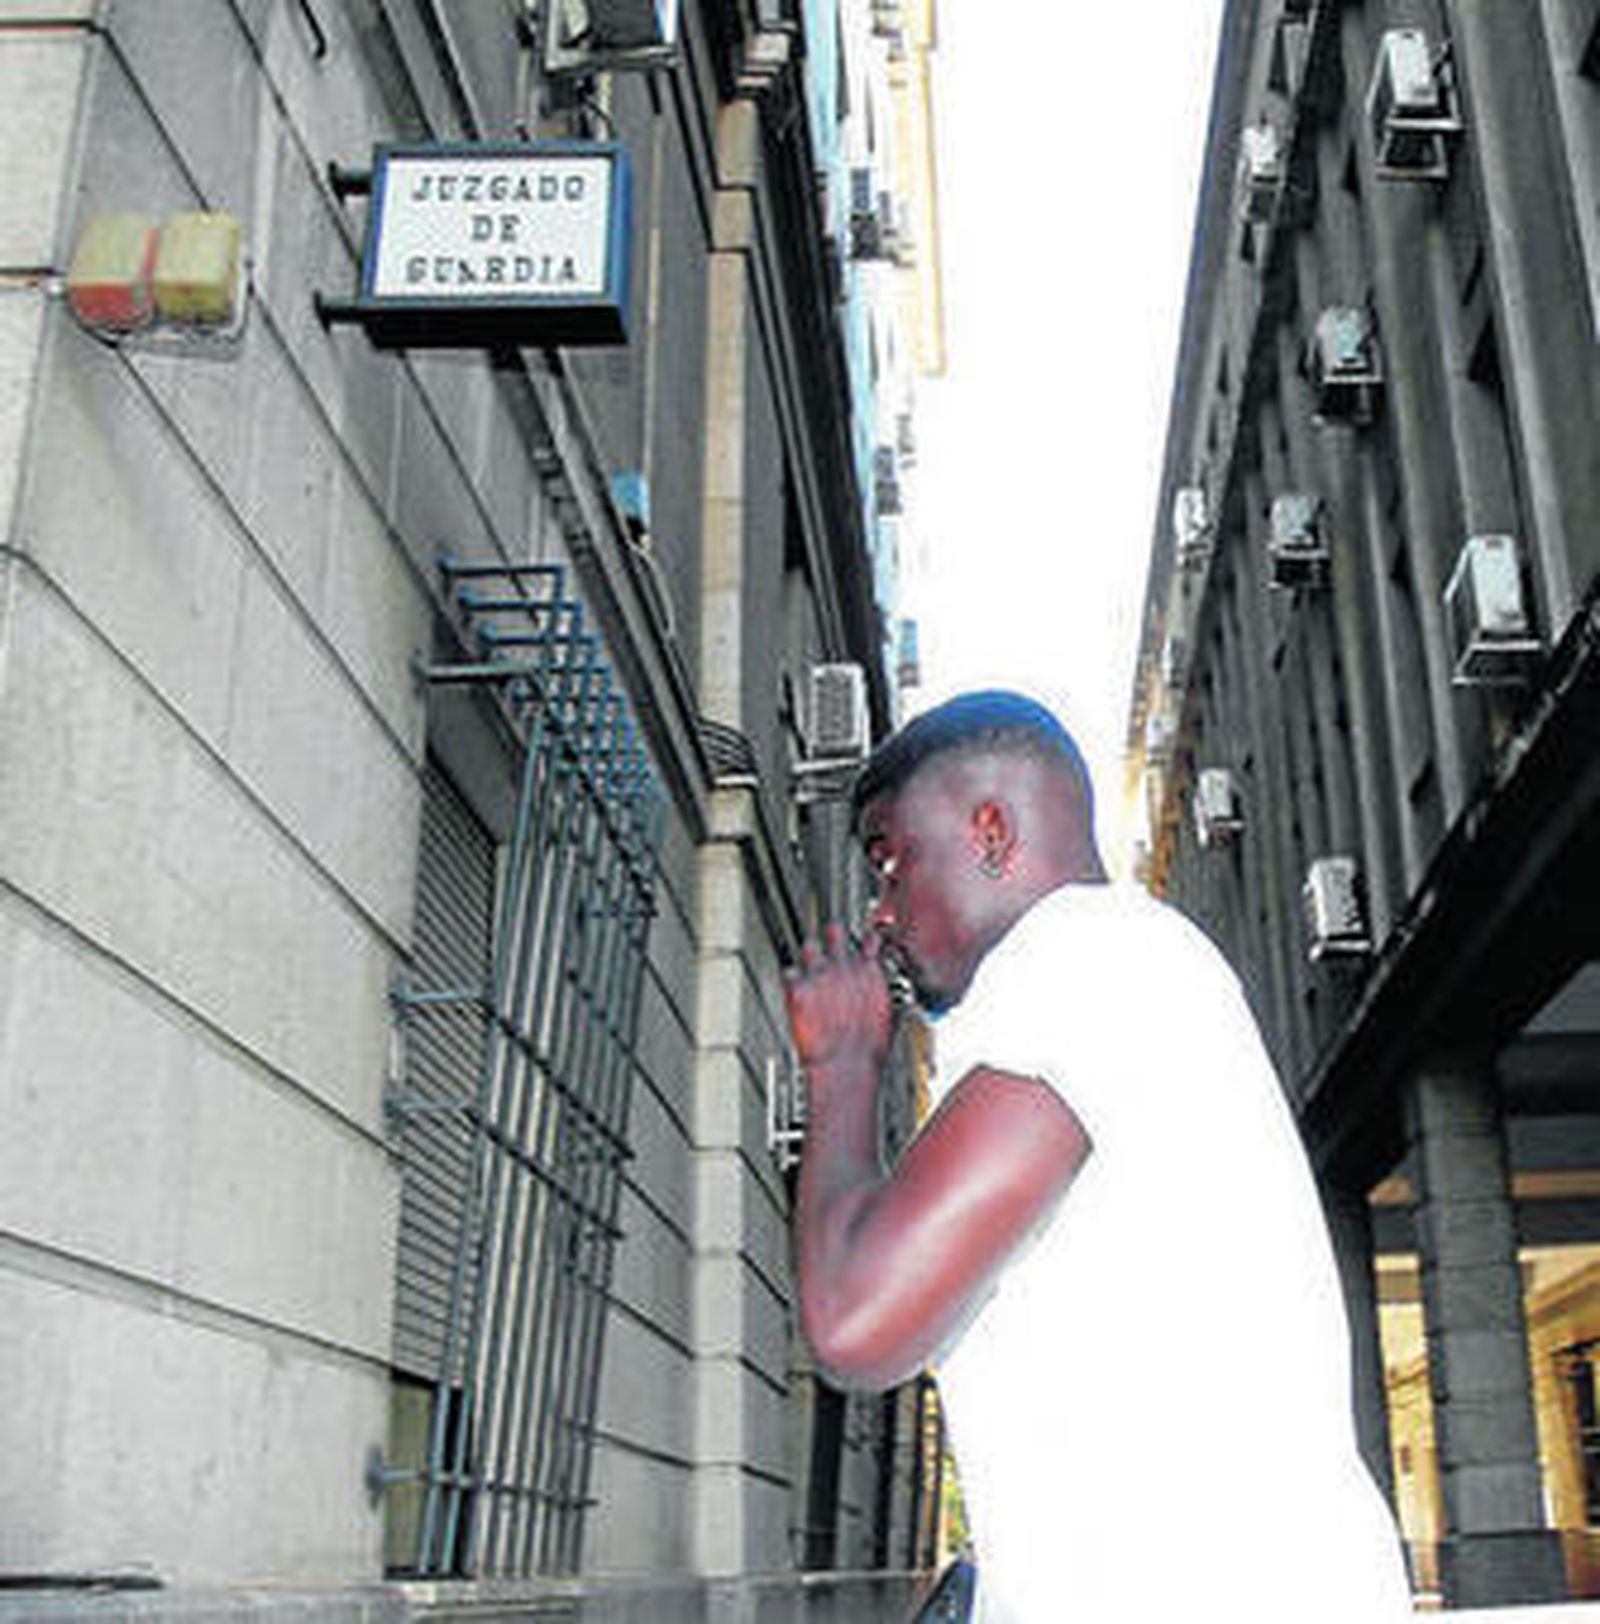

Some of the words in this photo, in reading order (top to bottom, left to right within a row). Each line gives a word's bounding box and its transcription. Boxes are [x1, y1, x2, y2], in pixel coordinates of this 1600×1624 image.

[411, 175, 585, 202] JUZGADO
[471, 214, 521, 242] DE
[404, 256, 577, 284] GUARDIA
